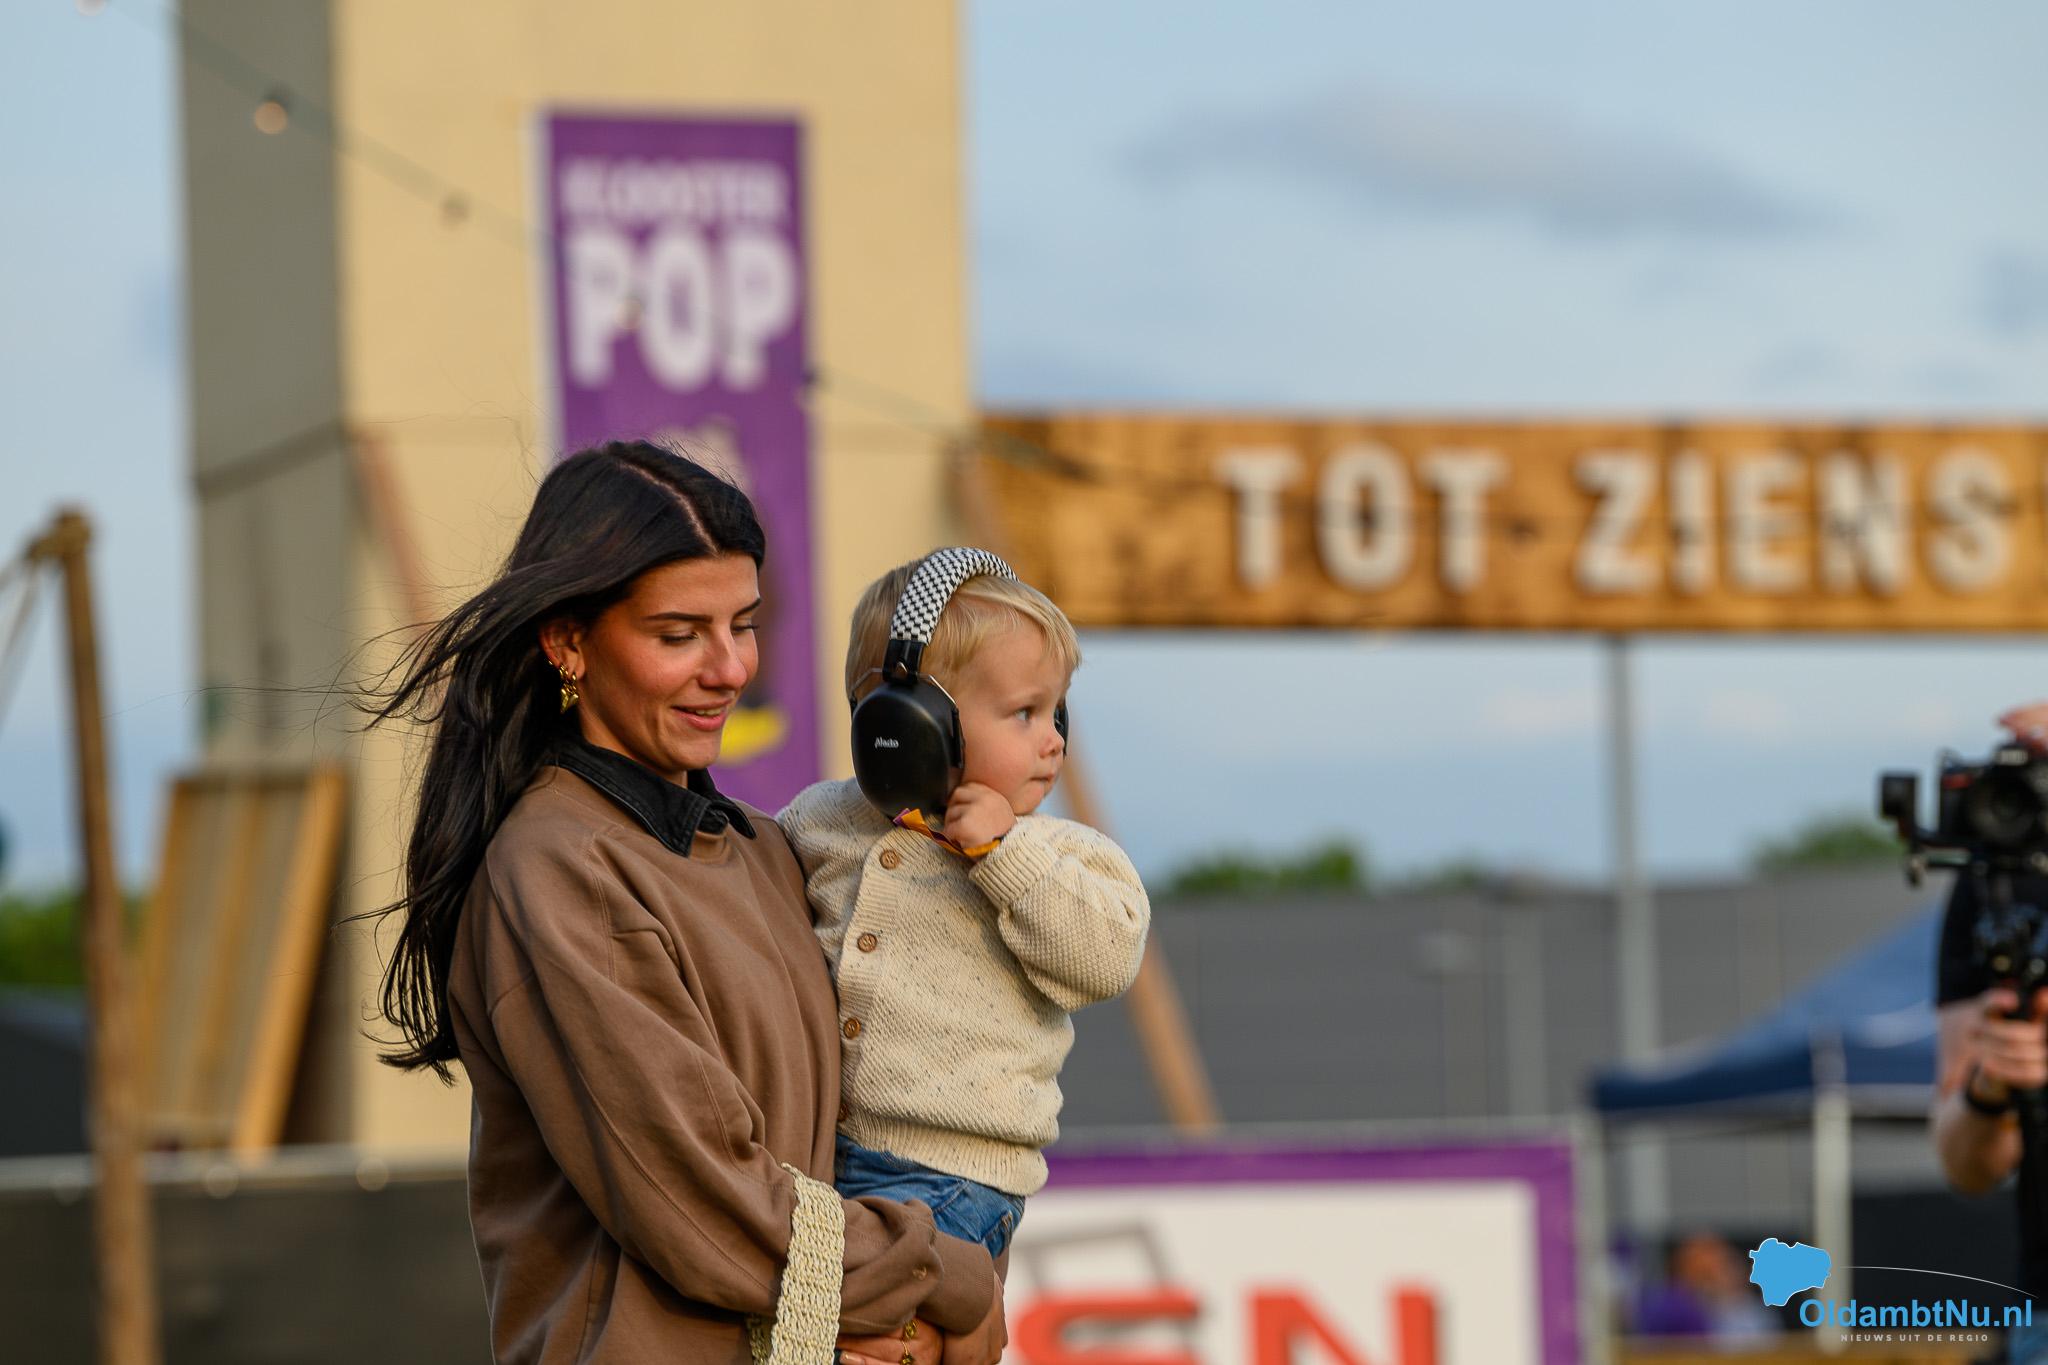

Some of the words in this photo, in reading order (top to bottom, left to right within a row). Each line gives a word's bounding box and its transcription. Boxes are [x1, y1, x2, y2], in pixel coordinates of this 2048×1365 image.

[568, 231, 793, 389] POP
[1214, 443, 1508, 592] TOT
[1573, 445, 2014, 595] ZIENS
